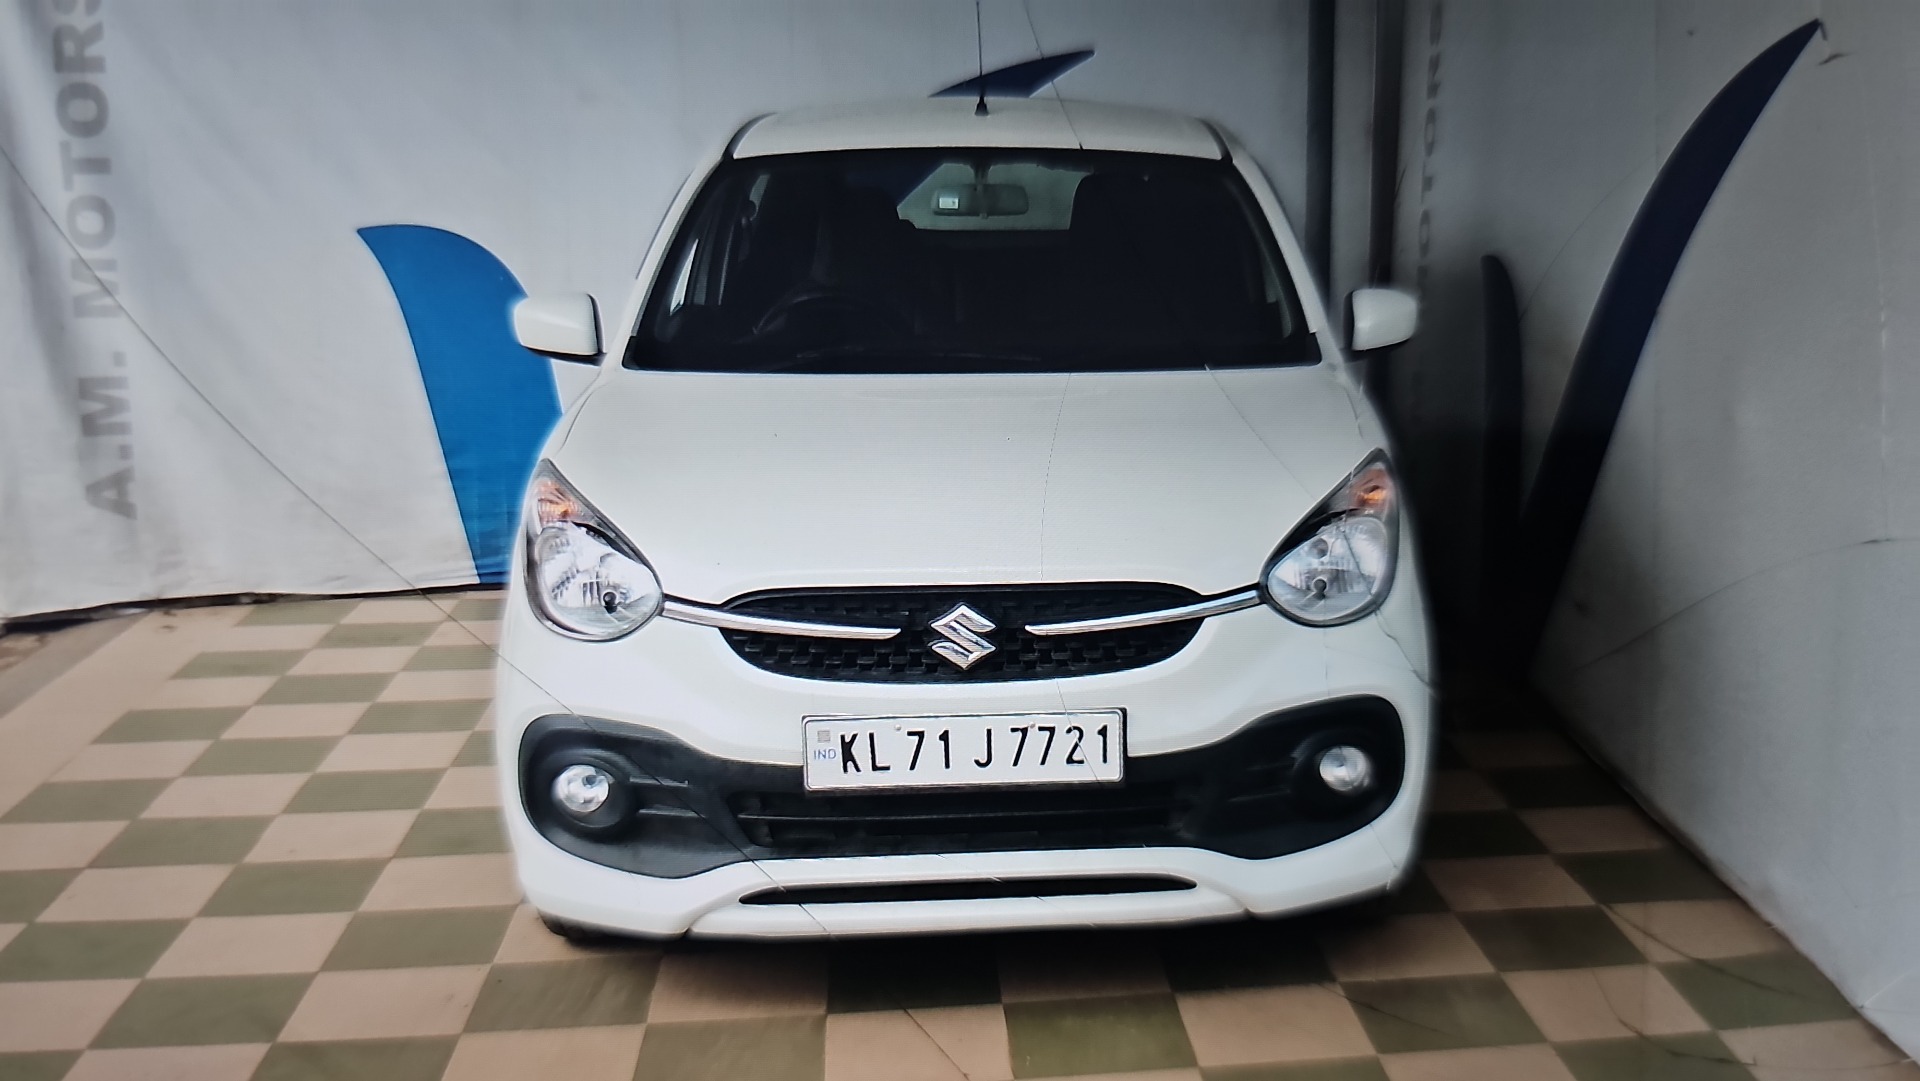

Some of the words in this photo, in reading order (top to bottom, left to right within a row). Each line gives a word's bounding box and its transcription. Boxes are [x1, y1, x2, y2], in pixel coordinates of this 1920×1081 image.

[79, 350, 138, 521] A.M.
[813, 748, 837, 761] IND
[839, 732, 891, 774] KL
[906, 729, 951, 771] 71
